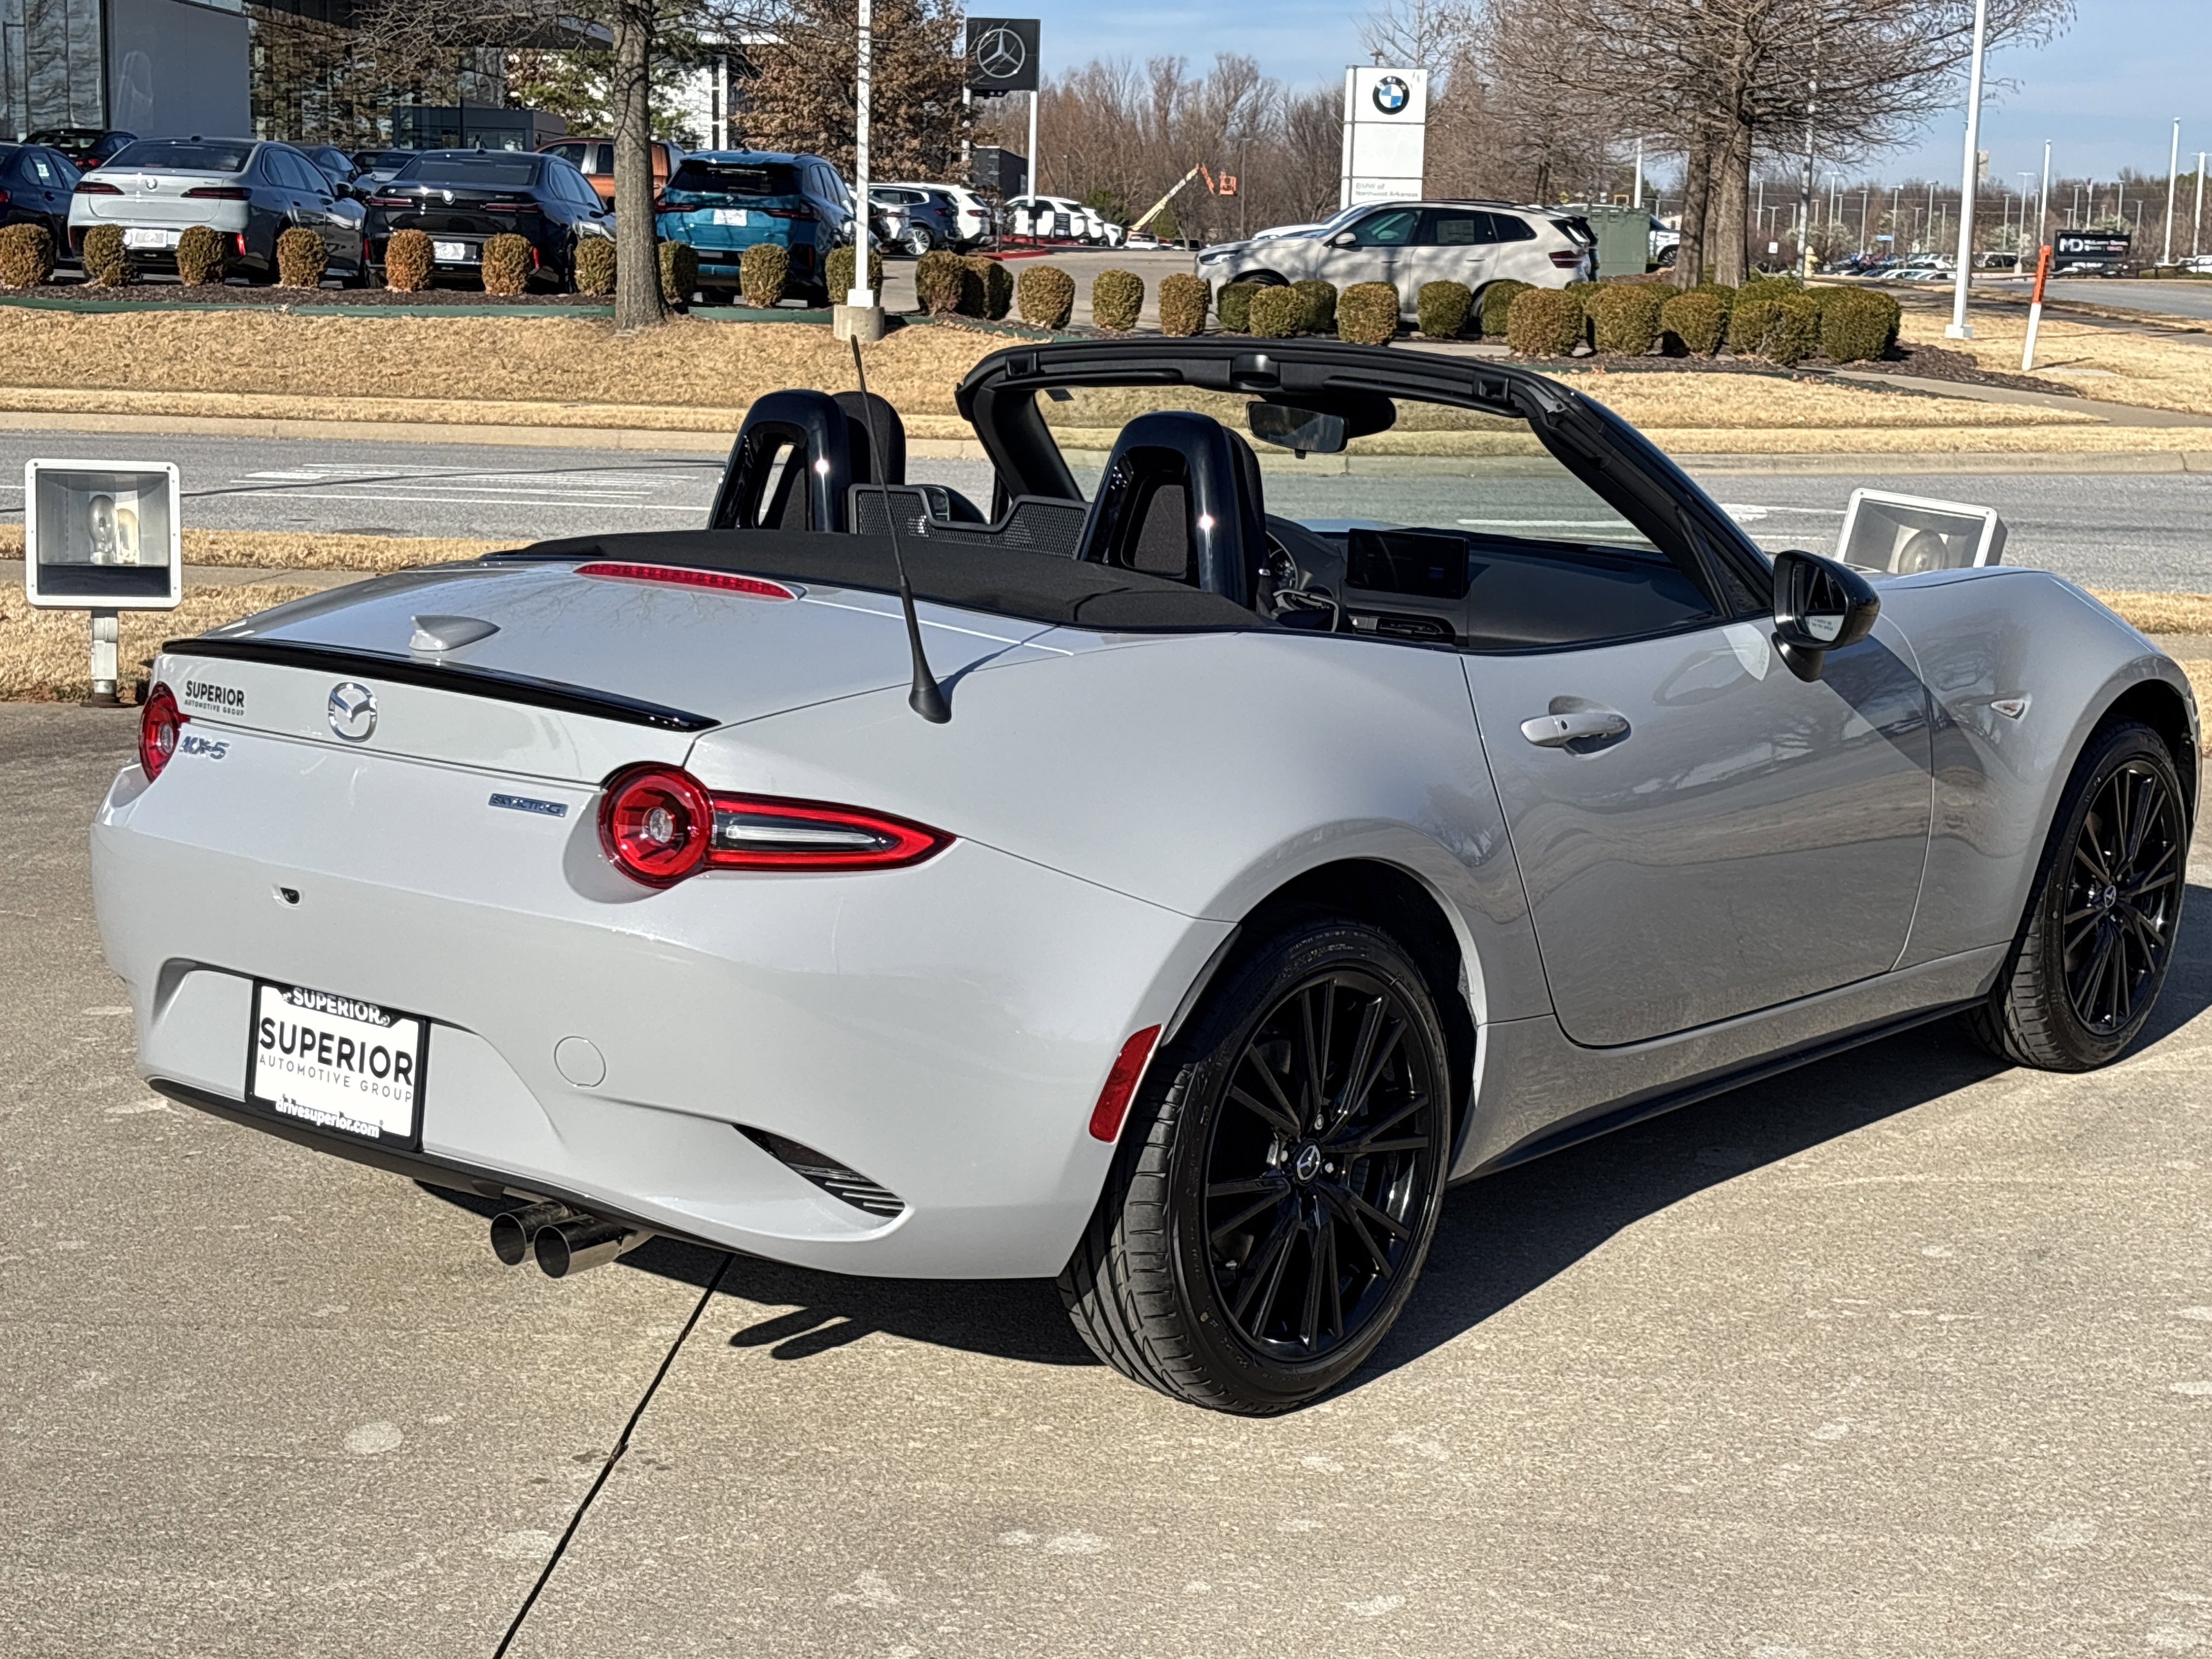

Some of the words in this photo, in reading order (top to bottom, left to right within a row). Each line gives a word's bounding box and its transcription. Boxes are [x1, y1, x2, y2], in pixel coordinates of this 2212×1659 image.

[184, 699, 221, 713] AUTOMOTIVE
[223, 707, 245, 716] GROUP
[185, 680, 245, 708] SUPERIOR
[292, 988, 383, 1025] SUPERIOR
[259, 1017, 413, 1086] SUPERIOR
[259, 1053, 351, 1087] AUTOMOTIVE
[360, 1080, 413, 1103] GROUP
[275, 1096, 380, 1138] drivesuperior.com
